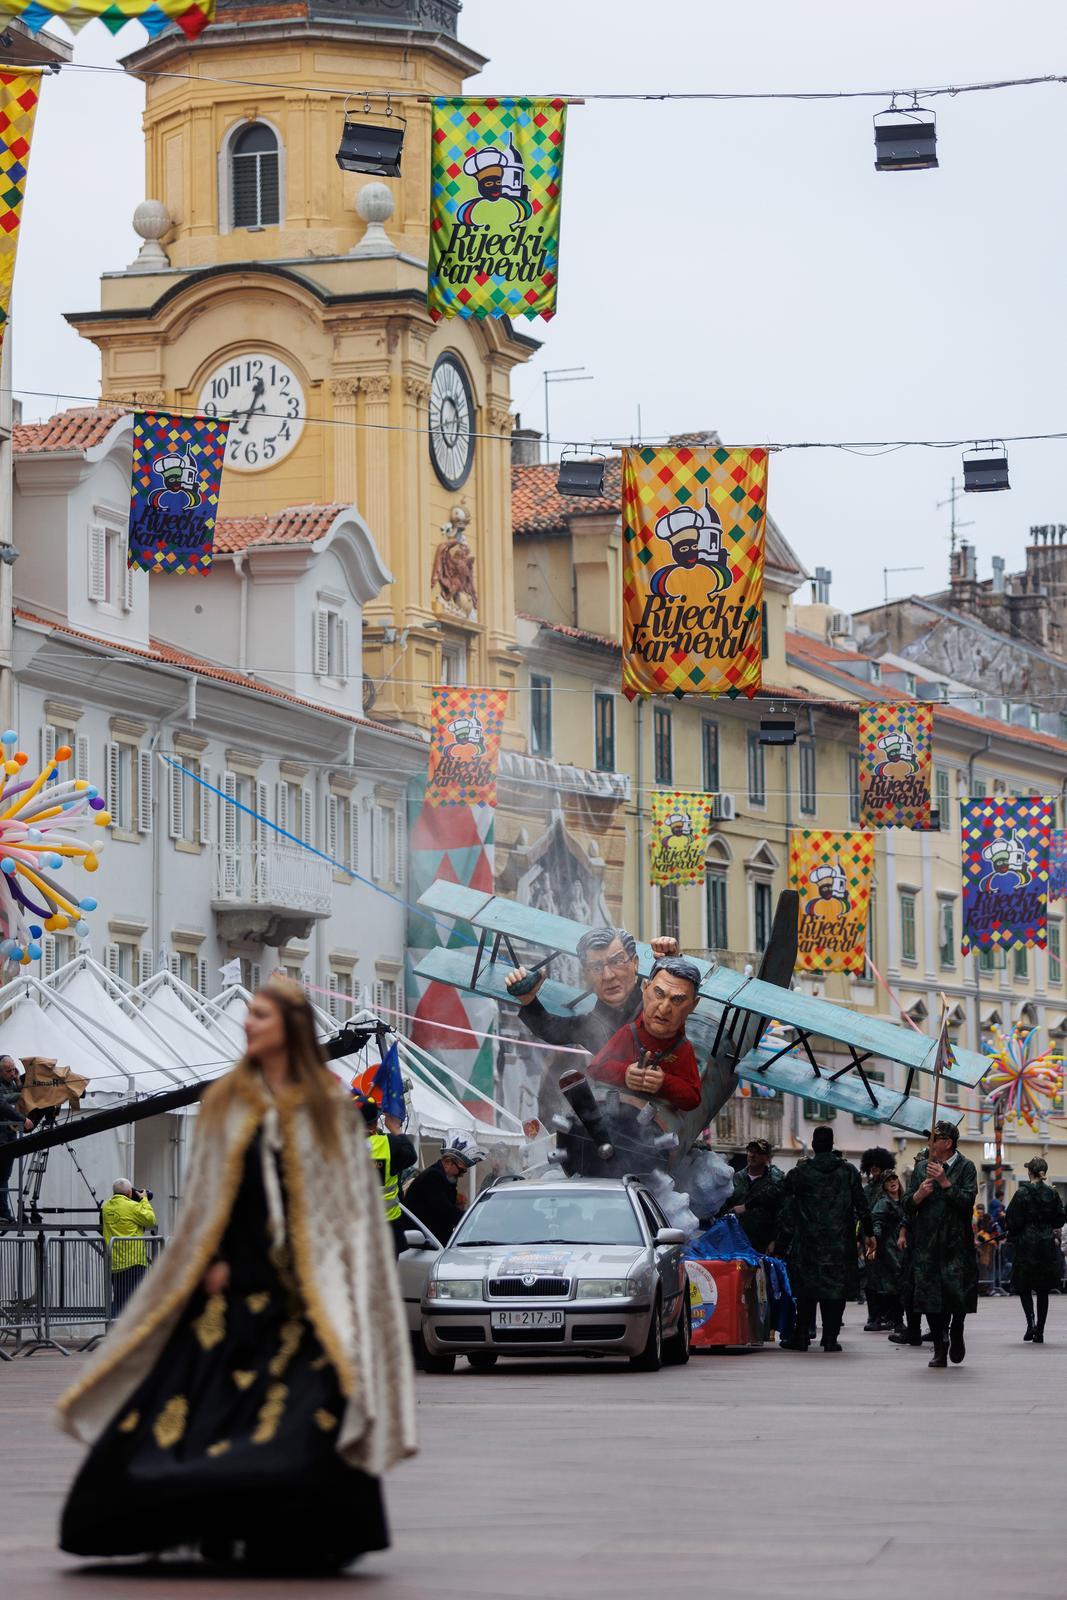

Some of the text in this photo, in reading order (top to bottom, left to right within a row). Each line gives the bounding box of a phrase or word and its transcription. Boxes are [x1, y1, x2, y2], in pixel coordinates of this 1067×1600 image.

[435, 248, 547, 284] karneval
[229, 365, 240, 387] 11
[246, 360, 263, 381] 12
[269, 365, 276, 386] 1
[211, 377, 229, 399] 10
[280, 376, 290, 397] 2
[287, 397, 299, 419] 3
[278, 420, 290, 440] 4
[230, 439, 241, 460] 7
[245, 442, 258, 464] 6
[263, 435, 277, 459] 5
[640, 595, 745, 640] Riječki
[630, 621, 749, 662] karneval
[499, 1312, 512, 1324] RI
